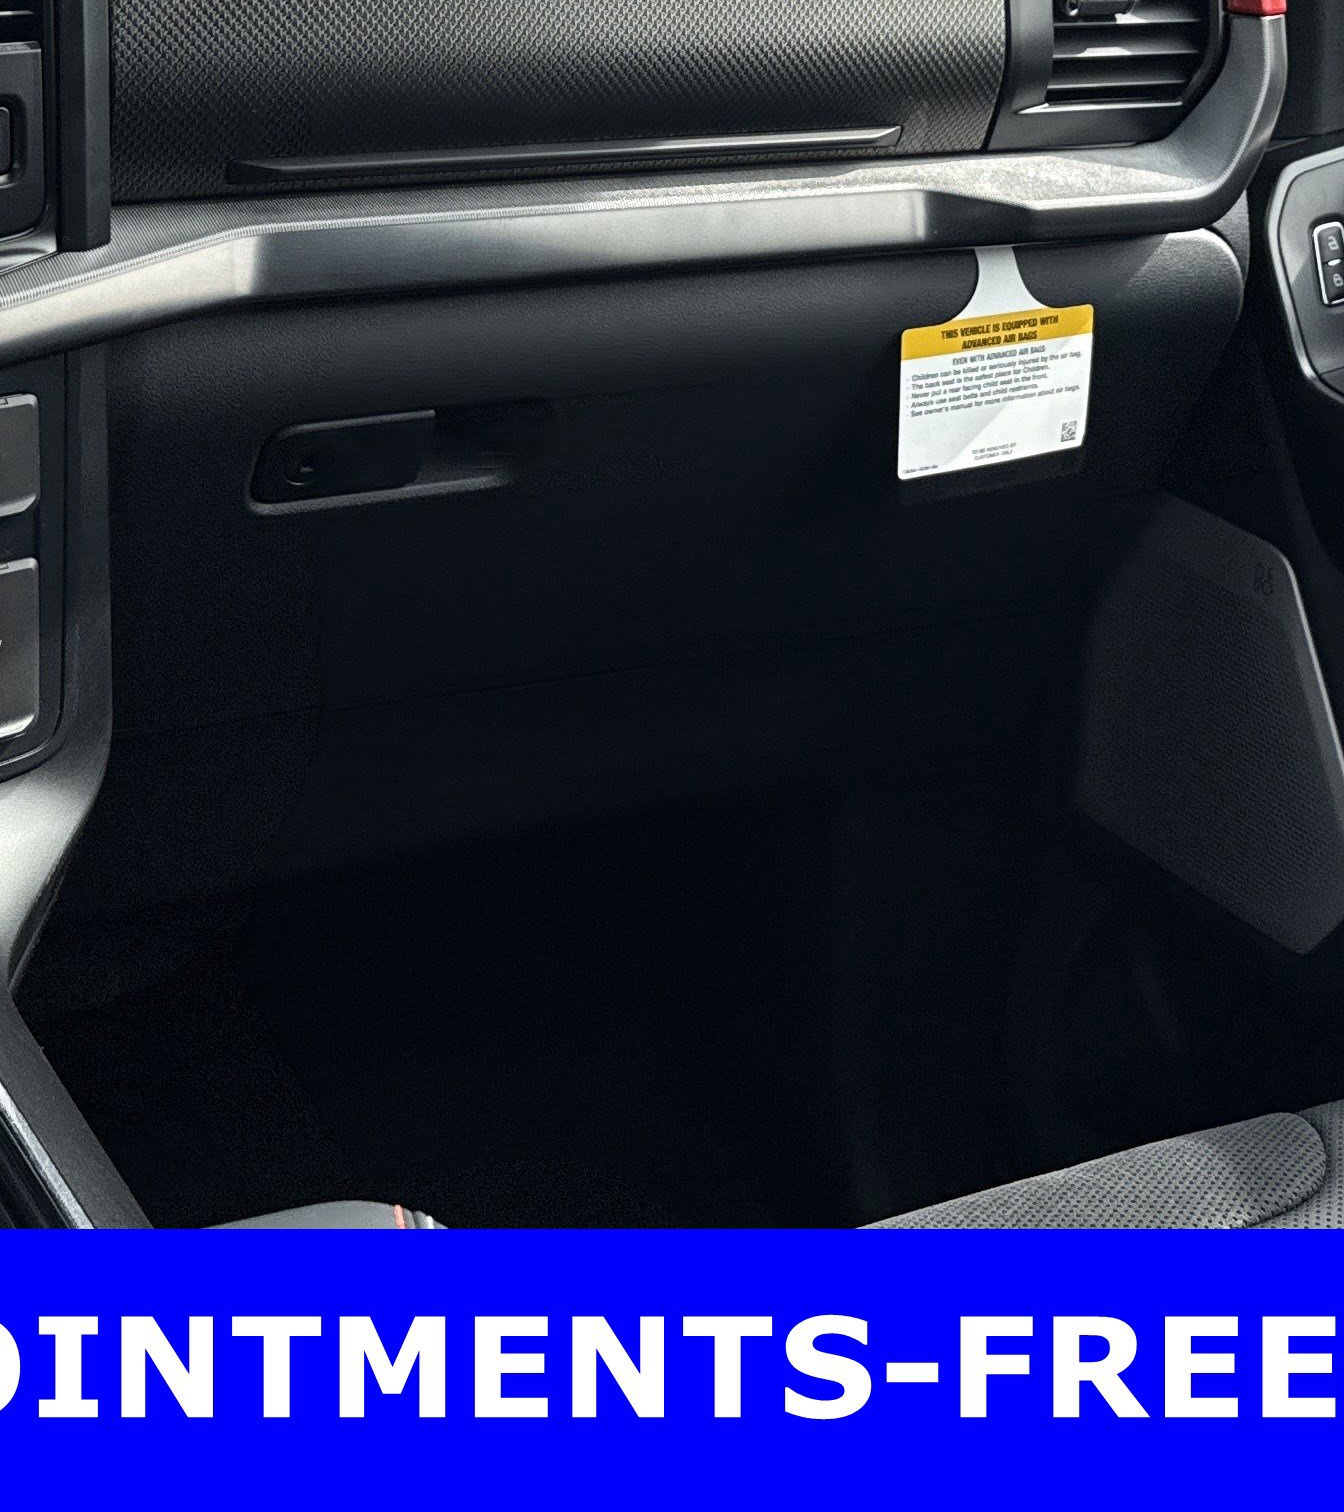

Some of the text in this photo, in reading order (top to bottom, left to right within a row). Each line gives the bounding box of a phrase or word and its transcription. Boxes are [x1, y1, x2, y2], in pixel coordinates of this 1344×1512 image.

[941, 315, 1059, 339] THIS VEHICLE IS EQUIPPED WITH
[962, 331, 1038, 349] ADVANCED AIR BAGS
[912, 373, 939, 381] Children
[1018, 357, 1039, 365] injured
